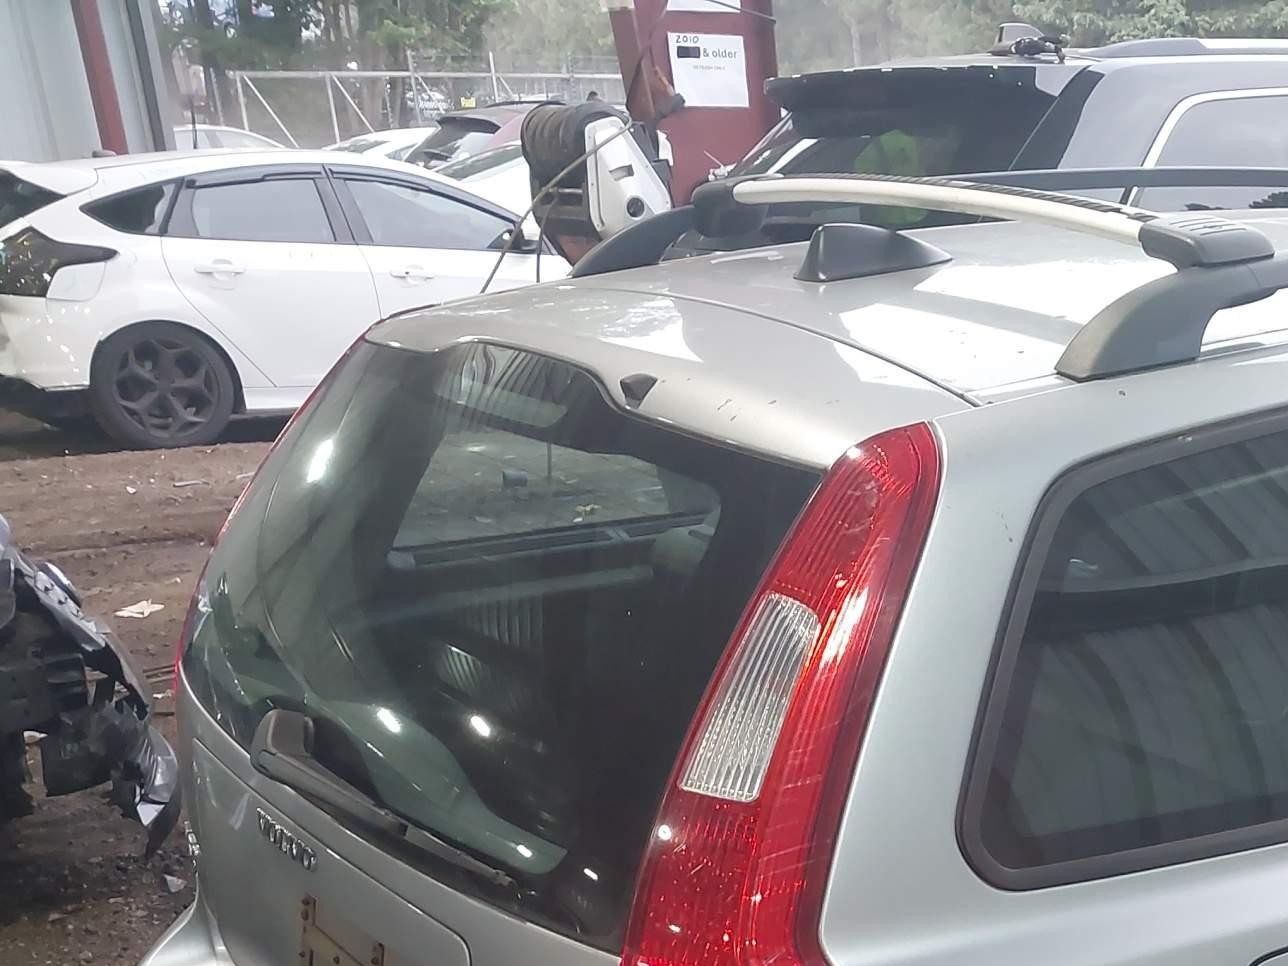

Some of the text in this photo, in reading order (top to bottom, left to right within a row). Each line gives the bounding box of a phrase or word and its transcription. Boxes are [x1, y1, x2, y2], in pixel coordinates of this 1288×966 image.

[675, 35, 699, 44] 2010
[702, 47, 738, 59] & older
[256, 807, 318, 872] VOLVO
